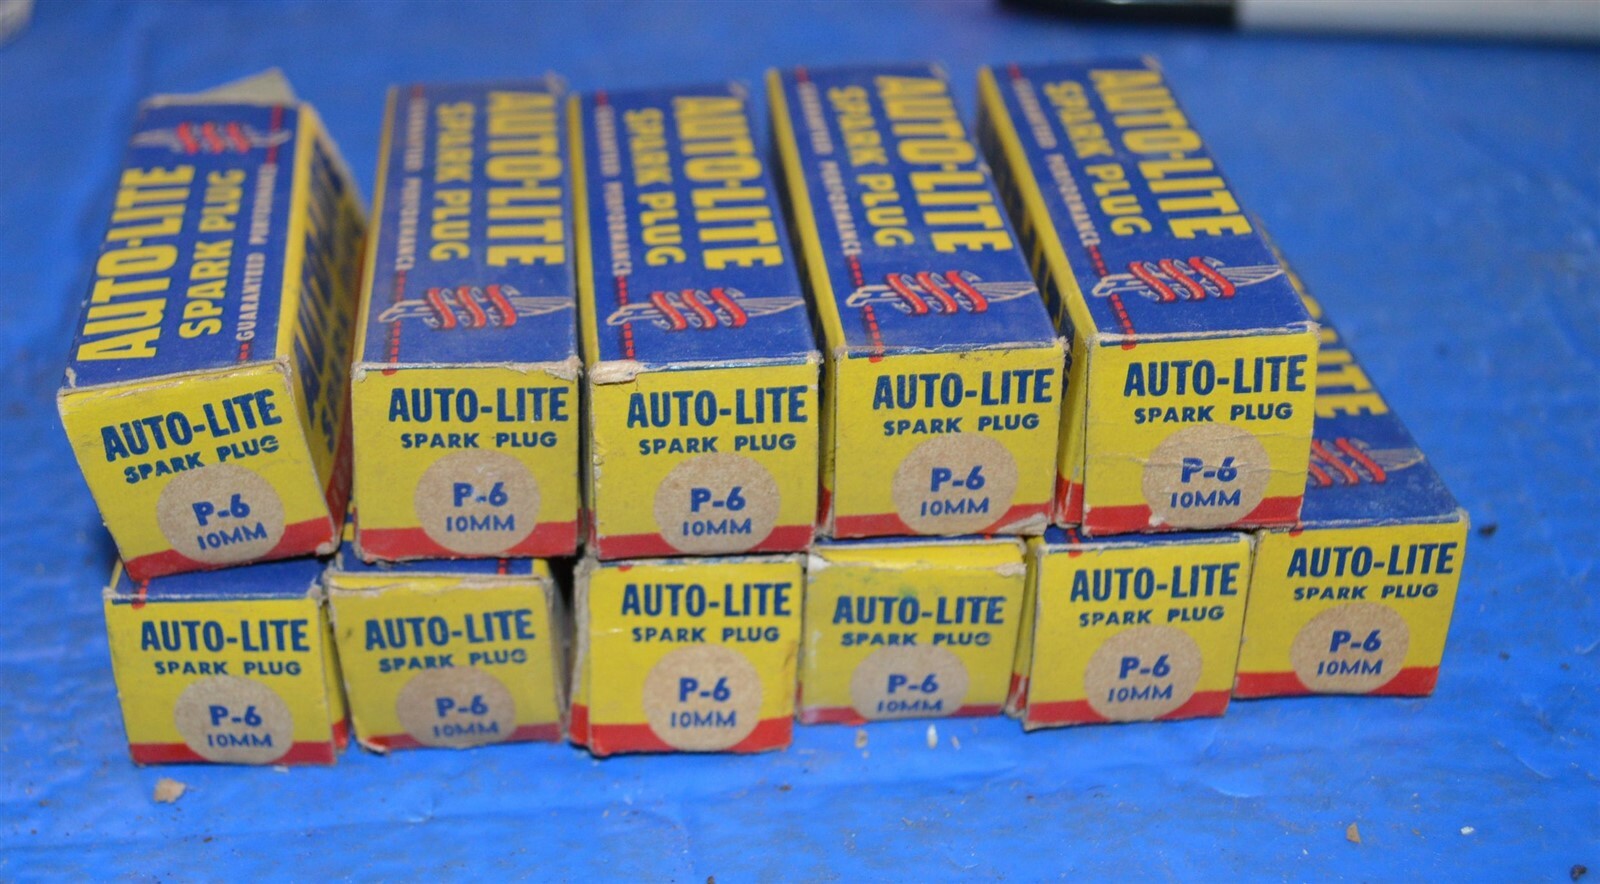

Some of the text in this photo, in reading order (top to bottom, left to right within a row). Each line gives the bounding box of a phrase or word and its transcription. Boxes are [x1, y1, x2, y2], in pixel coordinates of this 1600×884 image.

[1044, 80, 1152, 236] SPARK PLUG
[857, 173, 915, 247] PLUG
[429, 189, 472, 262] PLUG
[638, 191, 687, 266] PLUG
[178, 169, 246, 339] SPARK PLUG
[236, 252, 265, 341] GUARANTEED
[1123, 354, 1307, 397] AUTO-LITE
[873, 368, 1054, 410] AUTO-LITE
[388, 387, 569, 422] AUTO-LITE
[627, 385, 808, 428] AUTO-LITE
[1134, 403, 1293, 424] SPARK PLUG
[101, 389, 282, 461] AUTO-LITE
[883, 413, 1040, 436] SPARK PLUG
[401, 432, 557, 448] SPARK PLUG
[639, 434, 796, 455] SPARK PLUG
[124, 435, 279, 484] SPARK PLUG
[1181, 457, 1237, 483] P-6
[931, 466, 985, 492] P-6
[453, 482, 508, 507] P-6
[691, 486, 746, 512] P-6
[921, 498, 989, 516] 10MM
[1171, 489, 1241, 507] 10MM
[192, 494, 250, 525] P-6
[447, 514, 515, 531] 10MM
[683, 518, 752, 536] 10MM
[197, 522, 267, 550] 10MM
[1287, 542, 1457, 578] AUTO-LITE
[1070, 562, 1240, 602] AUTO-LITE
[1293, 584, 1439, 600] SPARK PLUG
[621, 582, 792, 617] AUTO-LITE
[832, 595, 1007, 625] AUTO-LITE
[1079, 605, 1225, 627] SPARK PLUG
[141, 619, 310, 652] AUTO-LITE
[365, 609, 535, 651] AUTO-LITE
[632, 626, 779, 642] SPARK PLUG
[841, 632, 991, 646] SPARK PLUG
[1329, 630, 1382, 653] P-6
[155, 661, 301, 676] SPARK PLUG
[379, 649, 527, 673] SPARK PLUG
[1119, 654, 1171, 680] P-6
[1317, 660, 1383, 677] 10MM
[679, 677, 731, 702] P-6
[887, 673, 939, 693] P-6
[1108, 684, 1174, 703] 10MM
[208, 705, 262, 727] P-6
[435, 695, 488, 718] P-6
[877, 699, 943, 713] 10MM
[433, 721, 499, 738] 10MM
[671, 710, 736, 728] 10MM
[207, 734, 273, 747] 10MM
